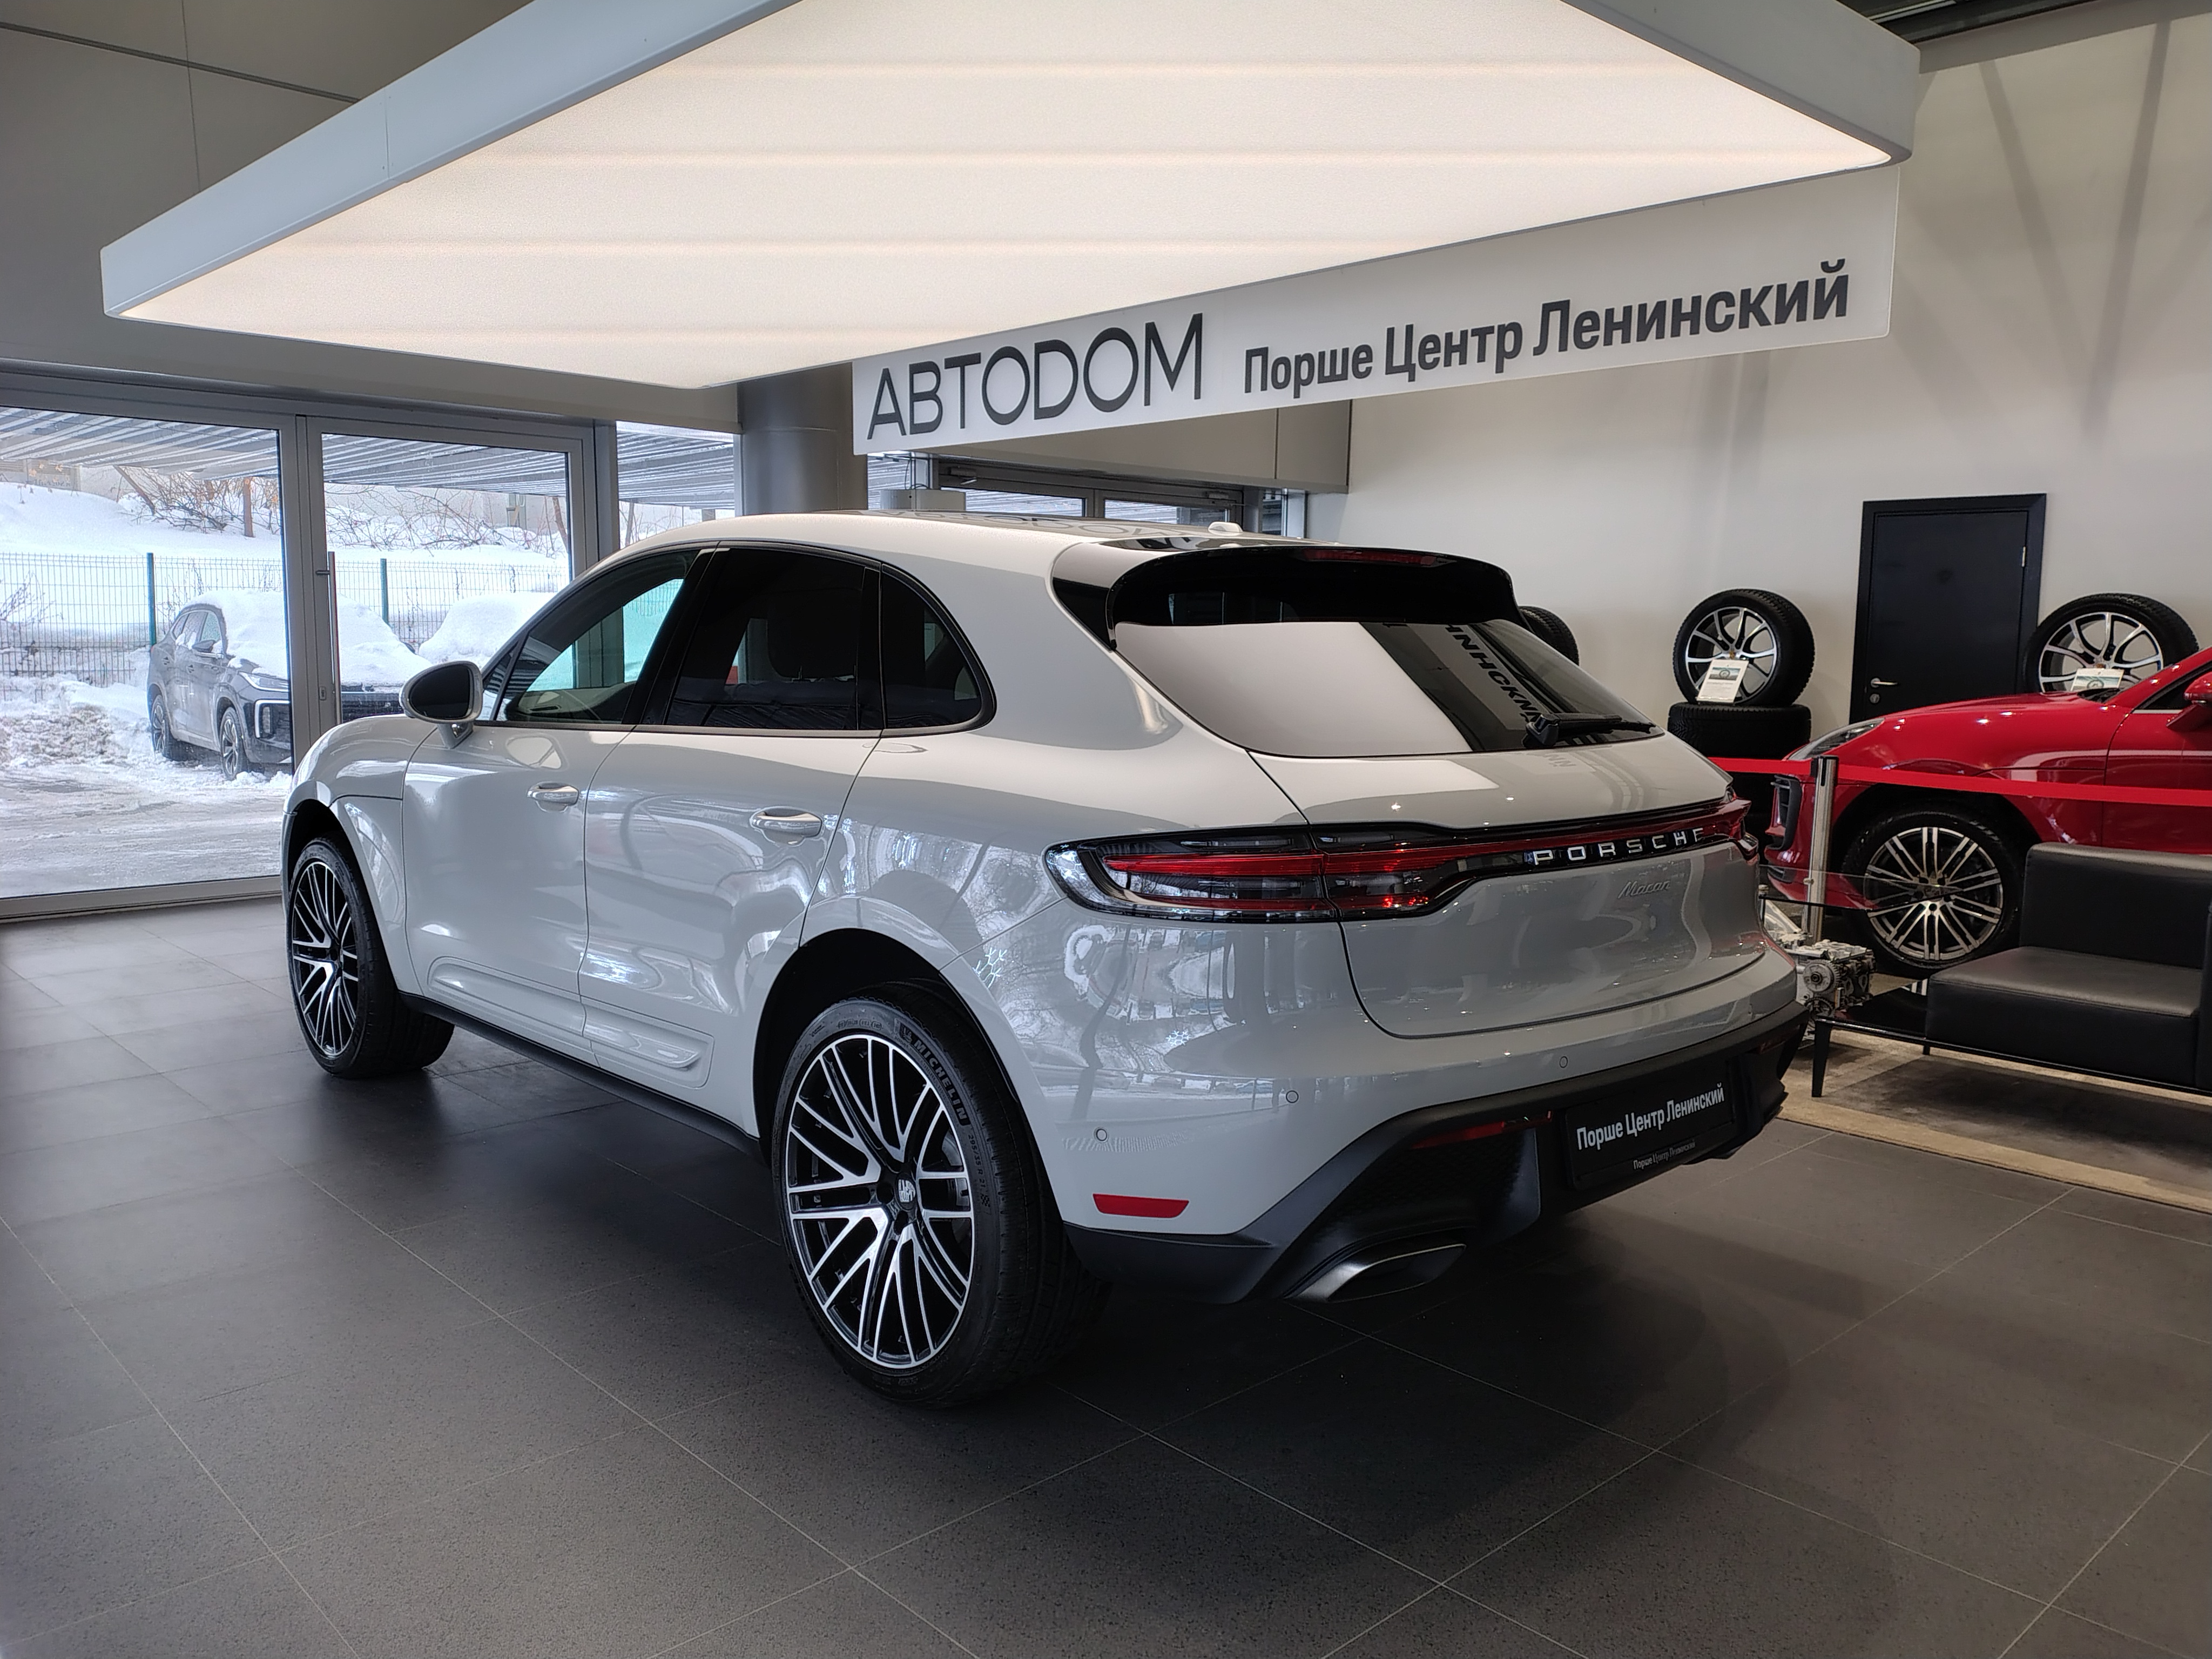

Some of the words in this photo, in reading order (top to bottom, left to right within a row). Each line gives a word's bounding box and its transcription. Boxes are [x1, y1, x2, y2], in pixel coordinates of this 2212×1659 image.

[1244, 344, 1373, 399] Порше
[1384, 320, 1523, 382] Центр
[1533, 258, 1849, 356] Ленинский
[1534, 828, 1705, 865] PORSCHE
[1618, 880, 1671, 899] Macan
[914, 1040, 967, 1120] MICHELIN
[1576, 1122, 1623, 1150] Порше
[1626, 1108, 1665, 1137] Центр
[1667, 1082, 1724, 1122] Ленинский
[1633, 1157, 1653, 1170] Порше
